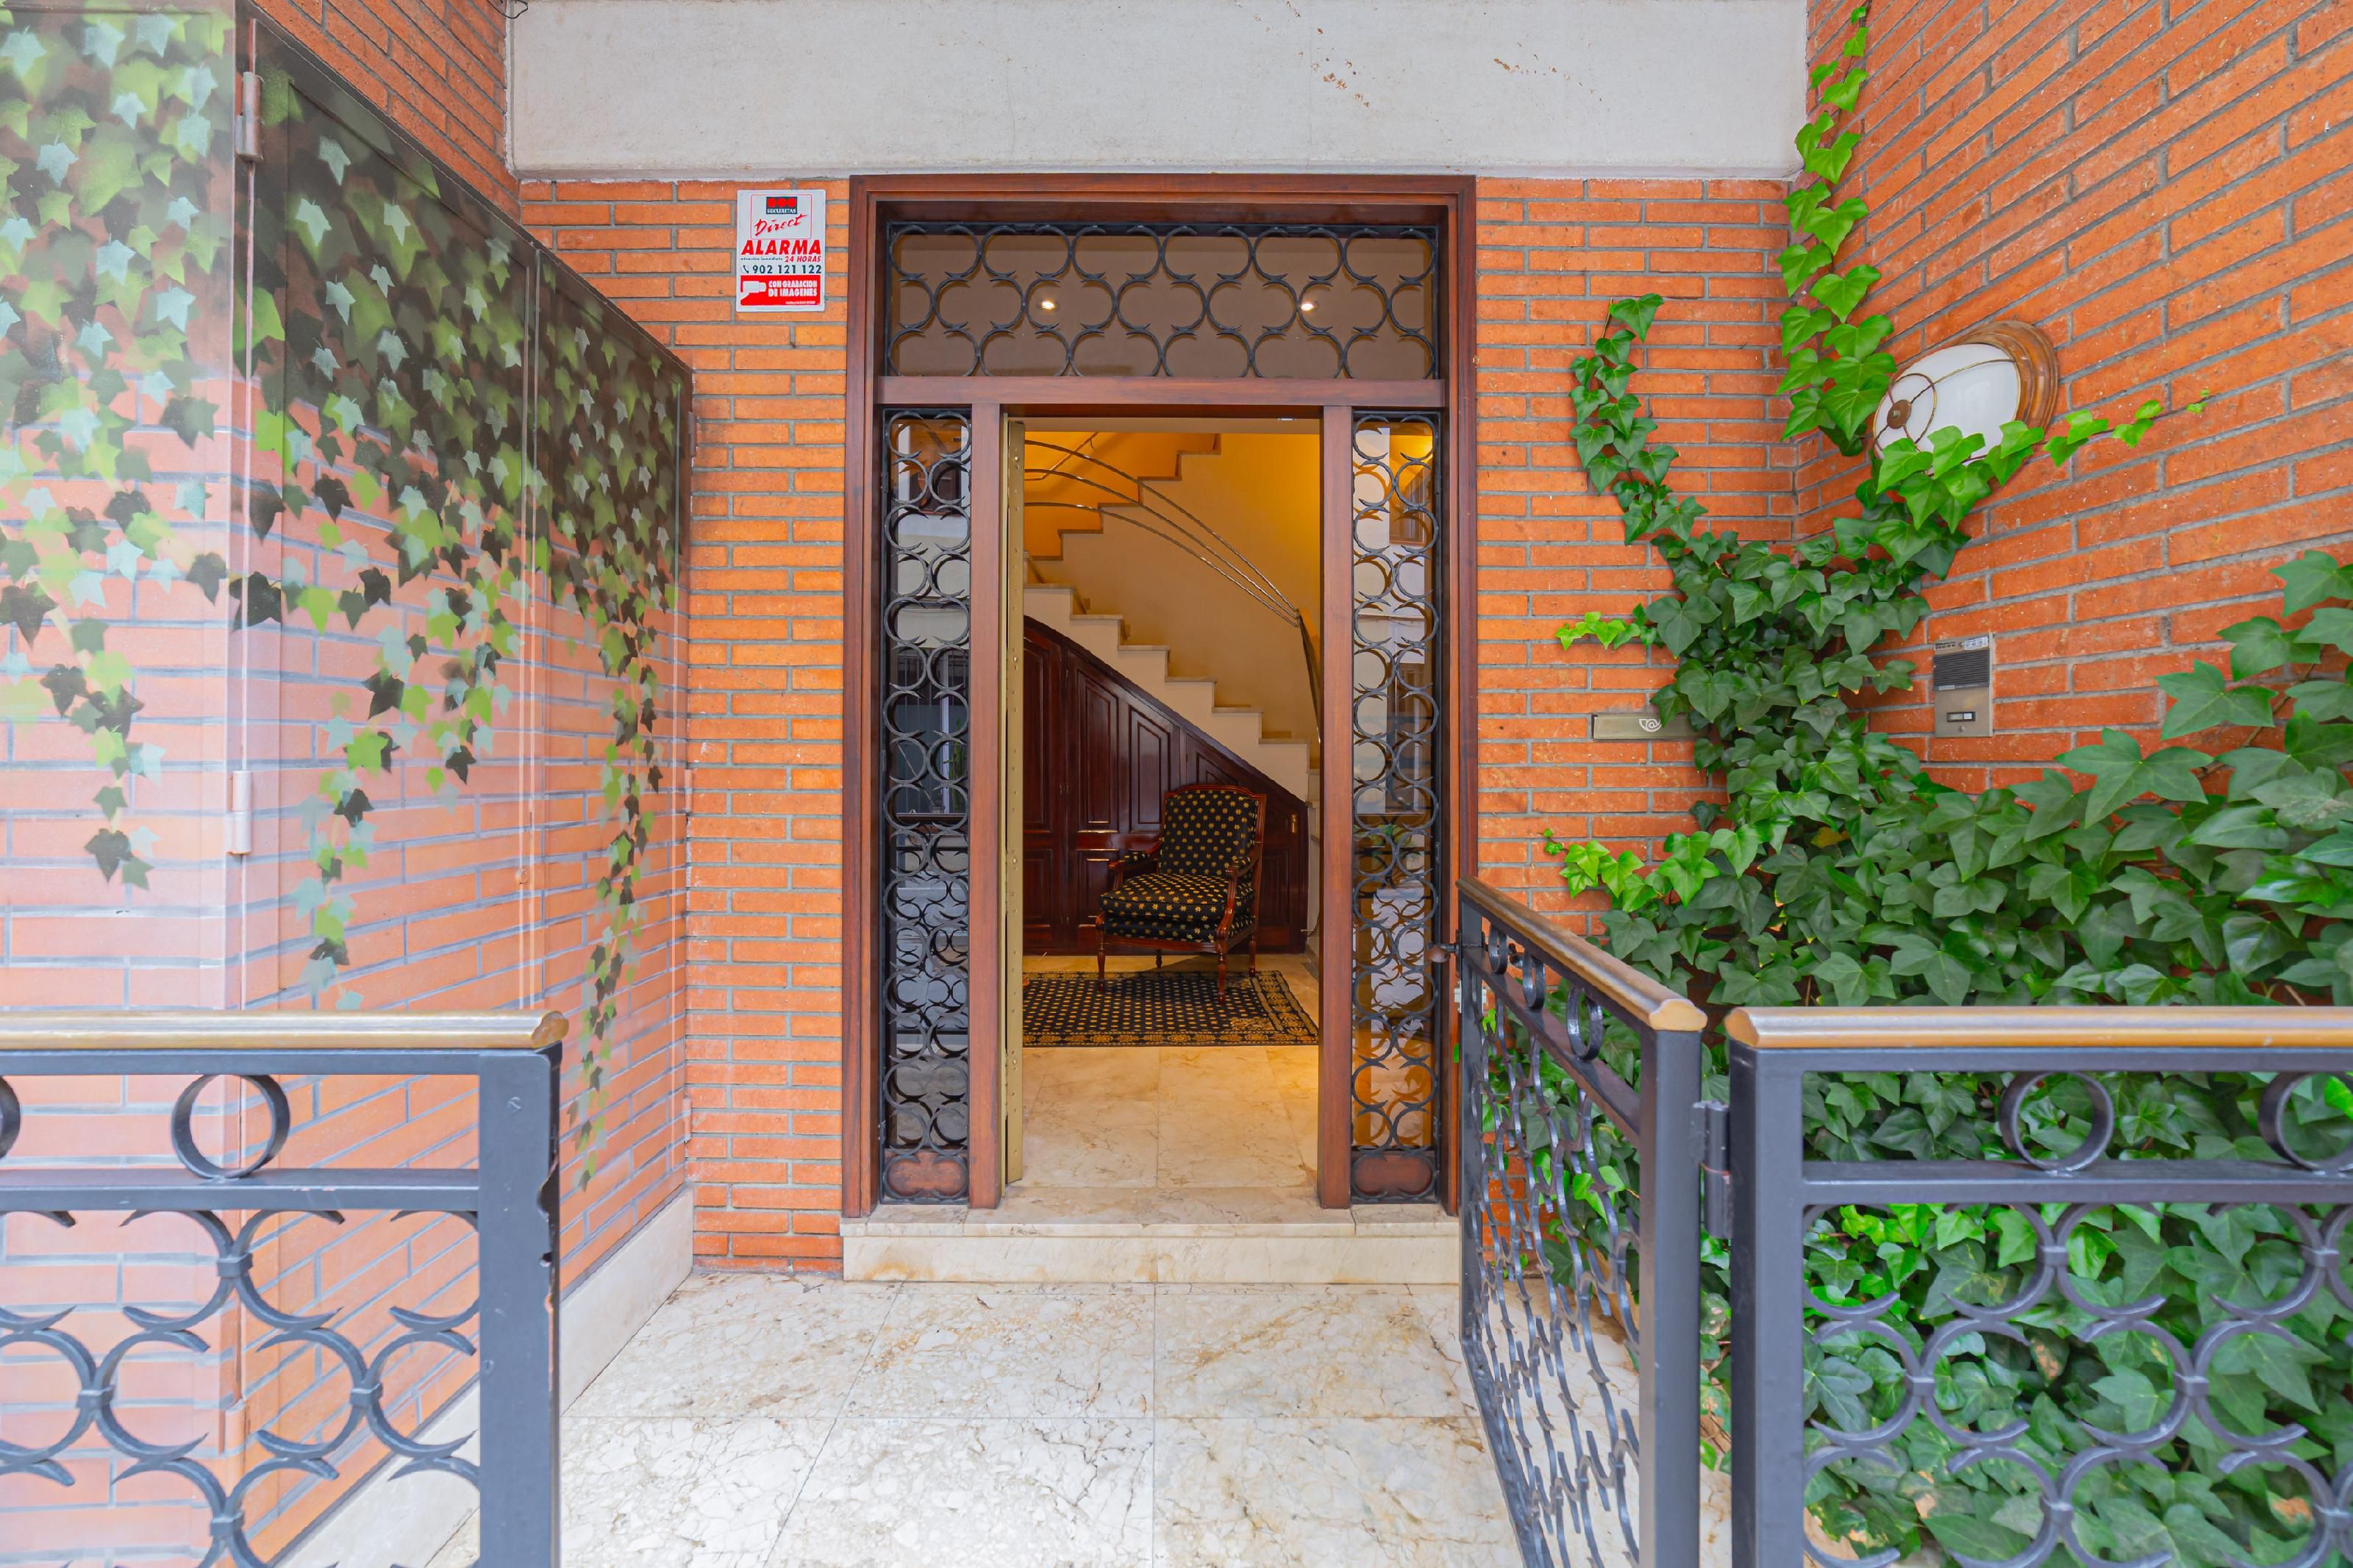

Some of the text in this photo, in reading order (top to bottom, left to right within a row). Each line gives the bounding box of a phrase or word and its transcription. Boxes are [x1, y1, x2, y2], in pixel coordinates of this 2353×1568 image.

[754, 213, 807, 237] Direct
[741, 240, 821, 255] ALARMA
[752, 265, 822, 273] 902 121 122
[768, 280, 782, 288] CON
[768, 288, 818, 297] DE IMAGENES
